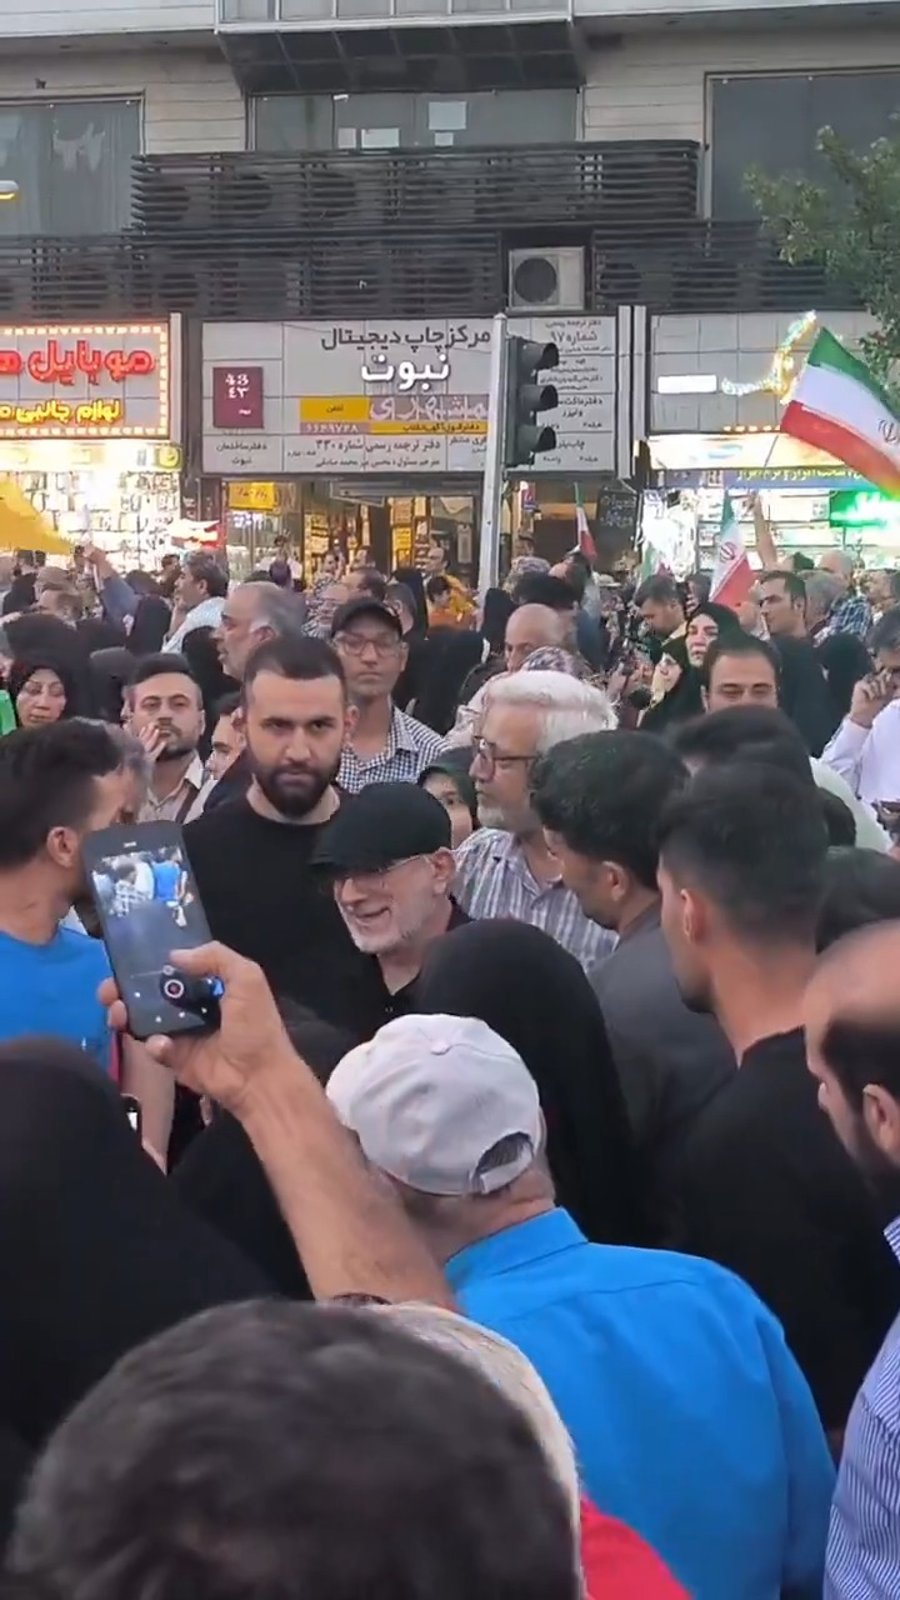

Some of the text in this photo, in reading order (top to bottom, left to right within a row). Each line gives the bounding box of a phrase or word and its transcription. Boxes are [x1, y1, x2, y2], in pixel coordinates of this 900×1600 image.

[321, 325, 491, 353] مرکز چاپ دیجیتال
[566, 330, 598, 346] شماره
[28, 340, 155, 385] موبایل
[361, 353, 450, 391] نبوت
[16, 400, 71, 425] جانبی
[75, 399, 122, 425] لوازم
[338, 439, 364, 453] شماره
[365, 443, 391, 453] رسمی
[394, 440, 420, 453] ترجمه
[422, 440, 441, 452] دفتر
